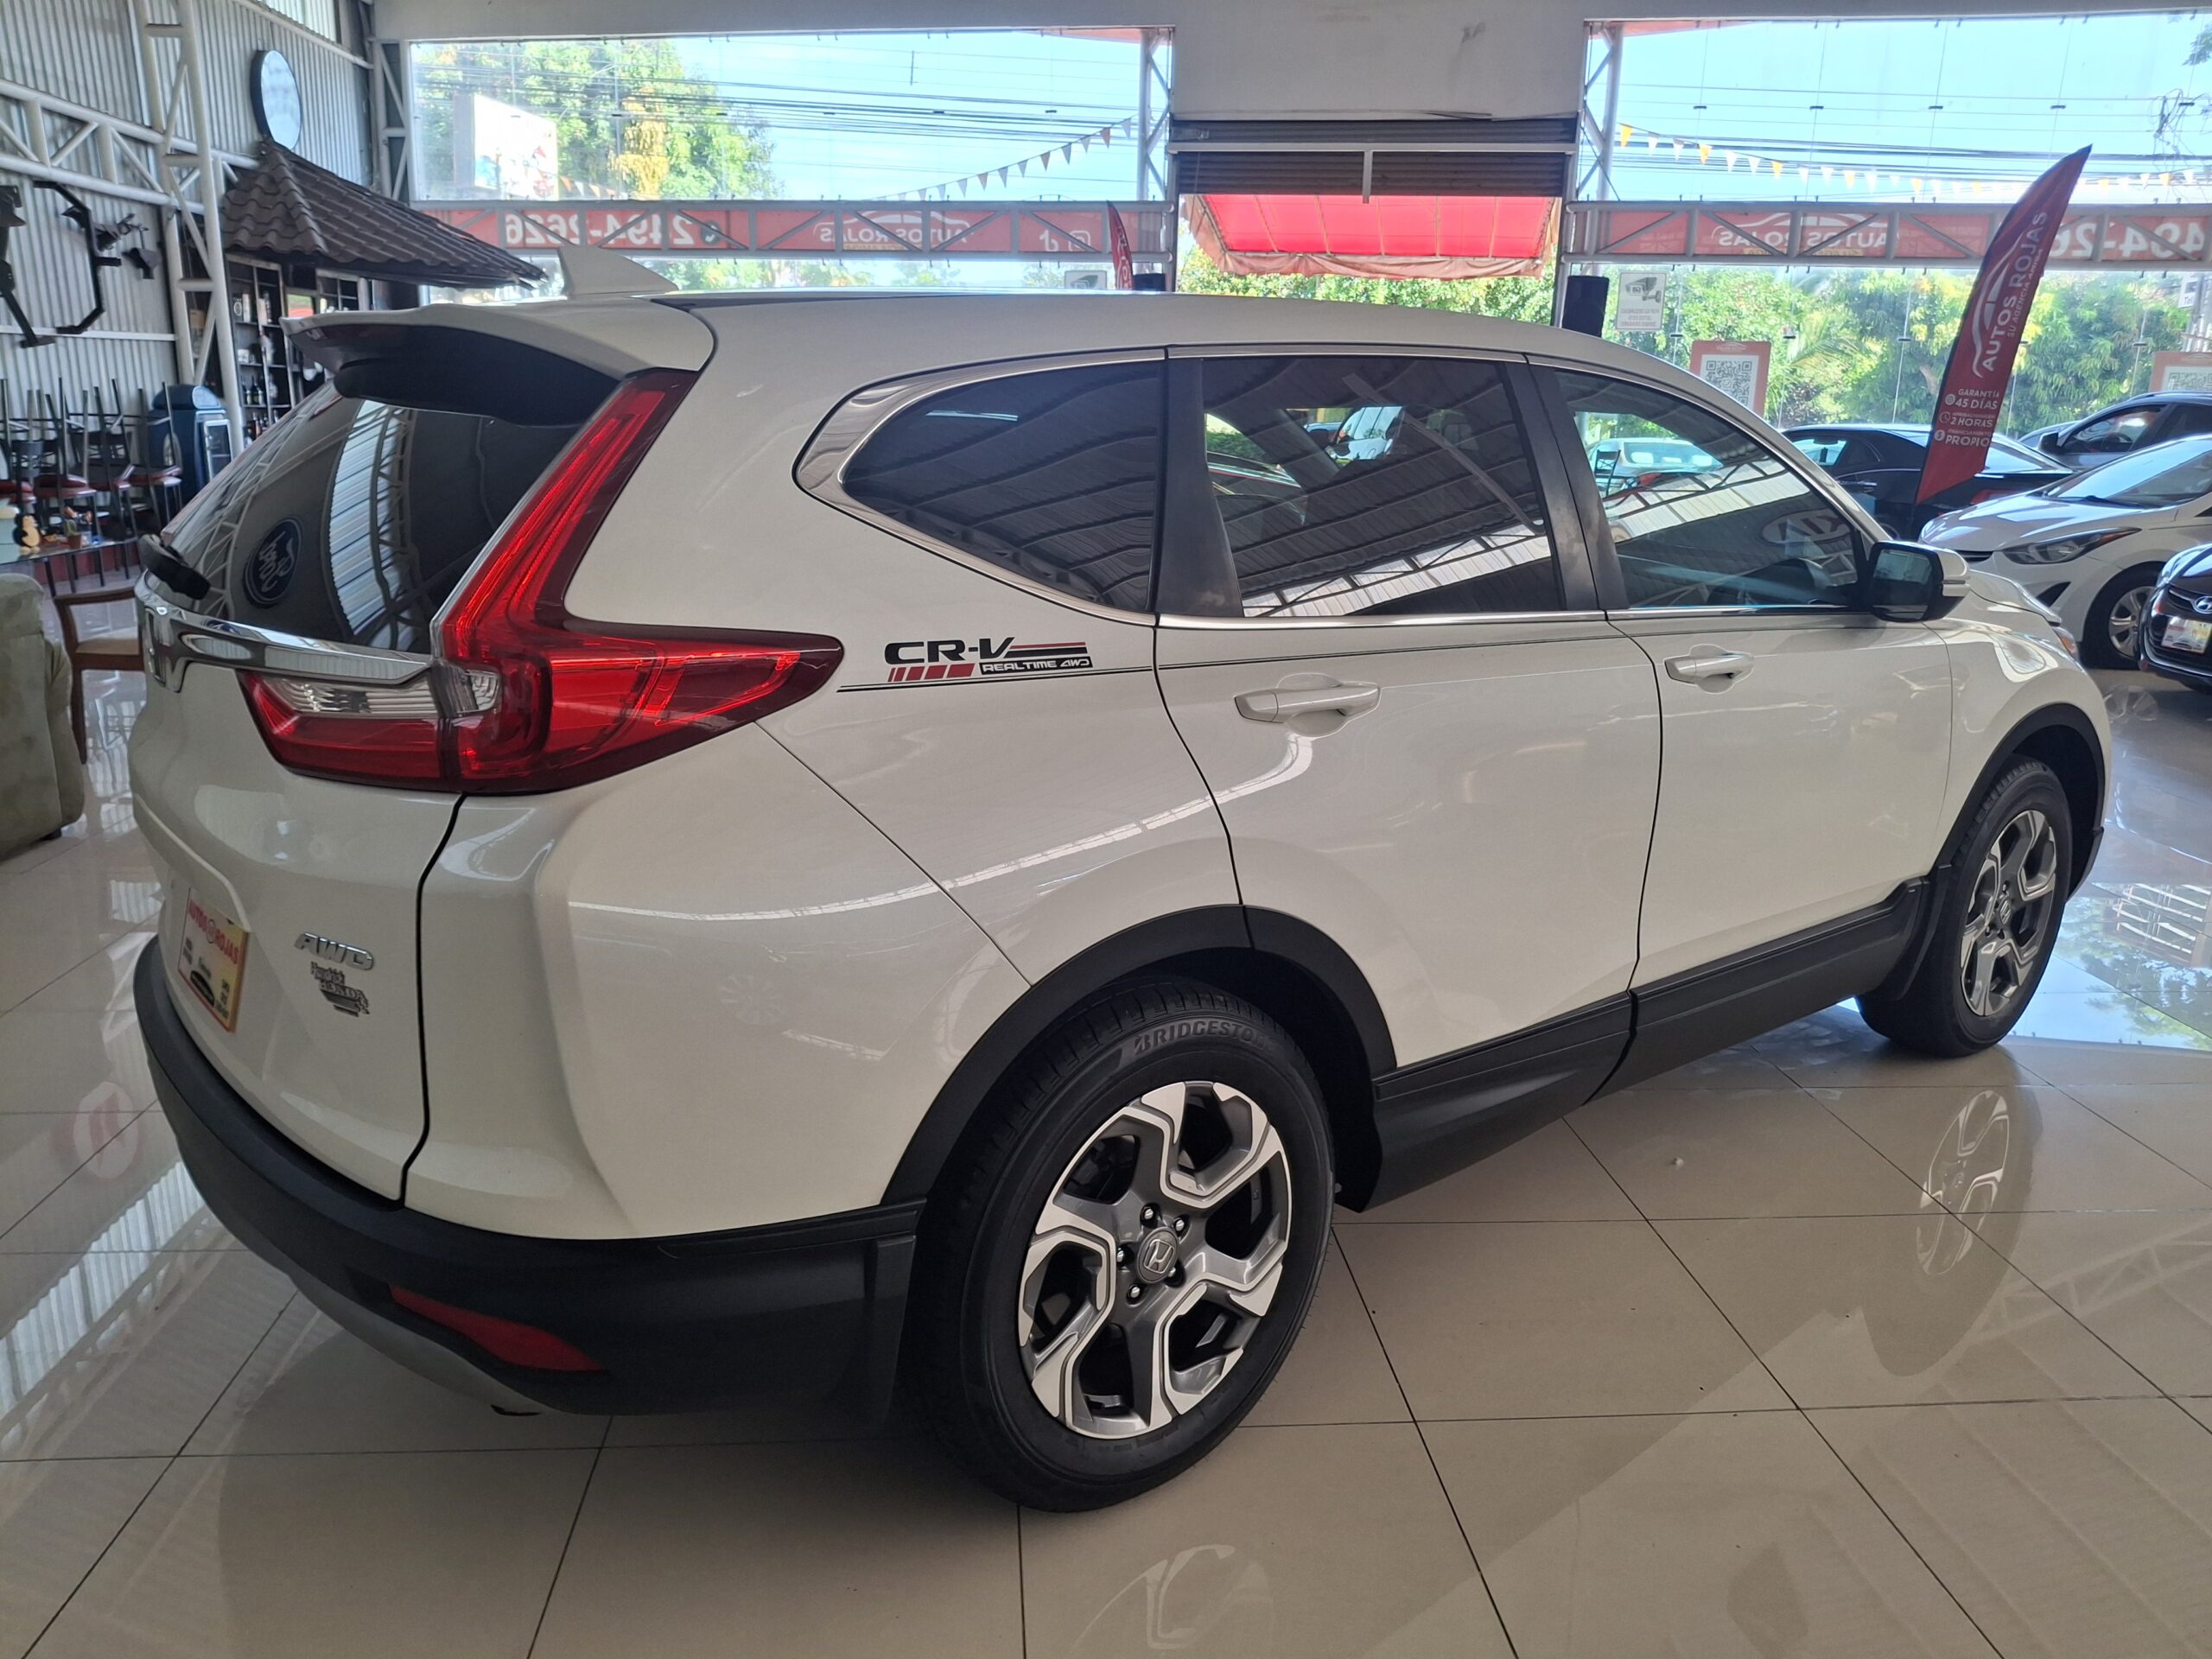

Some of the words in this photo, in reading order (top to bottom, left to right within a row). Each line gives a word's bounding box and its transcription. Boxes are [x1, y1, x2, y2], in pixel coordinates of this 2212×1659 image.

[1982, 296, 2018, 372] AUTOS
[2009, 212, 2048, 289] ROJAS
[1955, 397, 1968, 408] 45
[1970, 398, 1998, 410] DÍAS
[1950, 416, 1957, 425] 2
[1958, 417, 1993, 428] HORAS
[1945, 435, 1990, 447] PROPIO
[884, 636, 1015, 665] CR-V
[982, 660, 1057, 673] REALTIME
[294, 931, 374, 971] AWD
